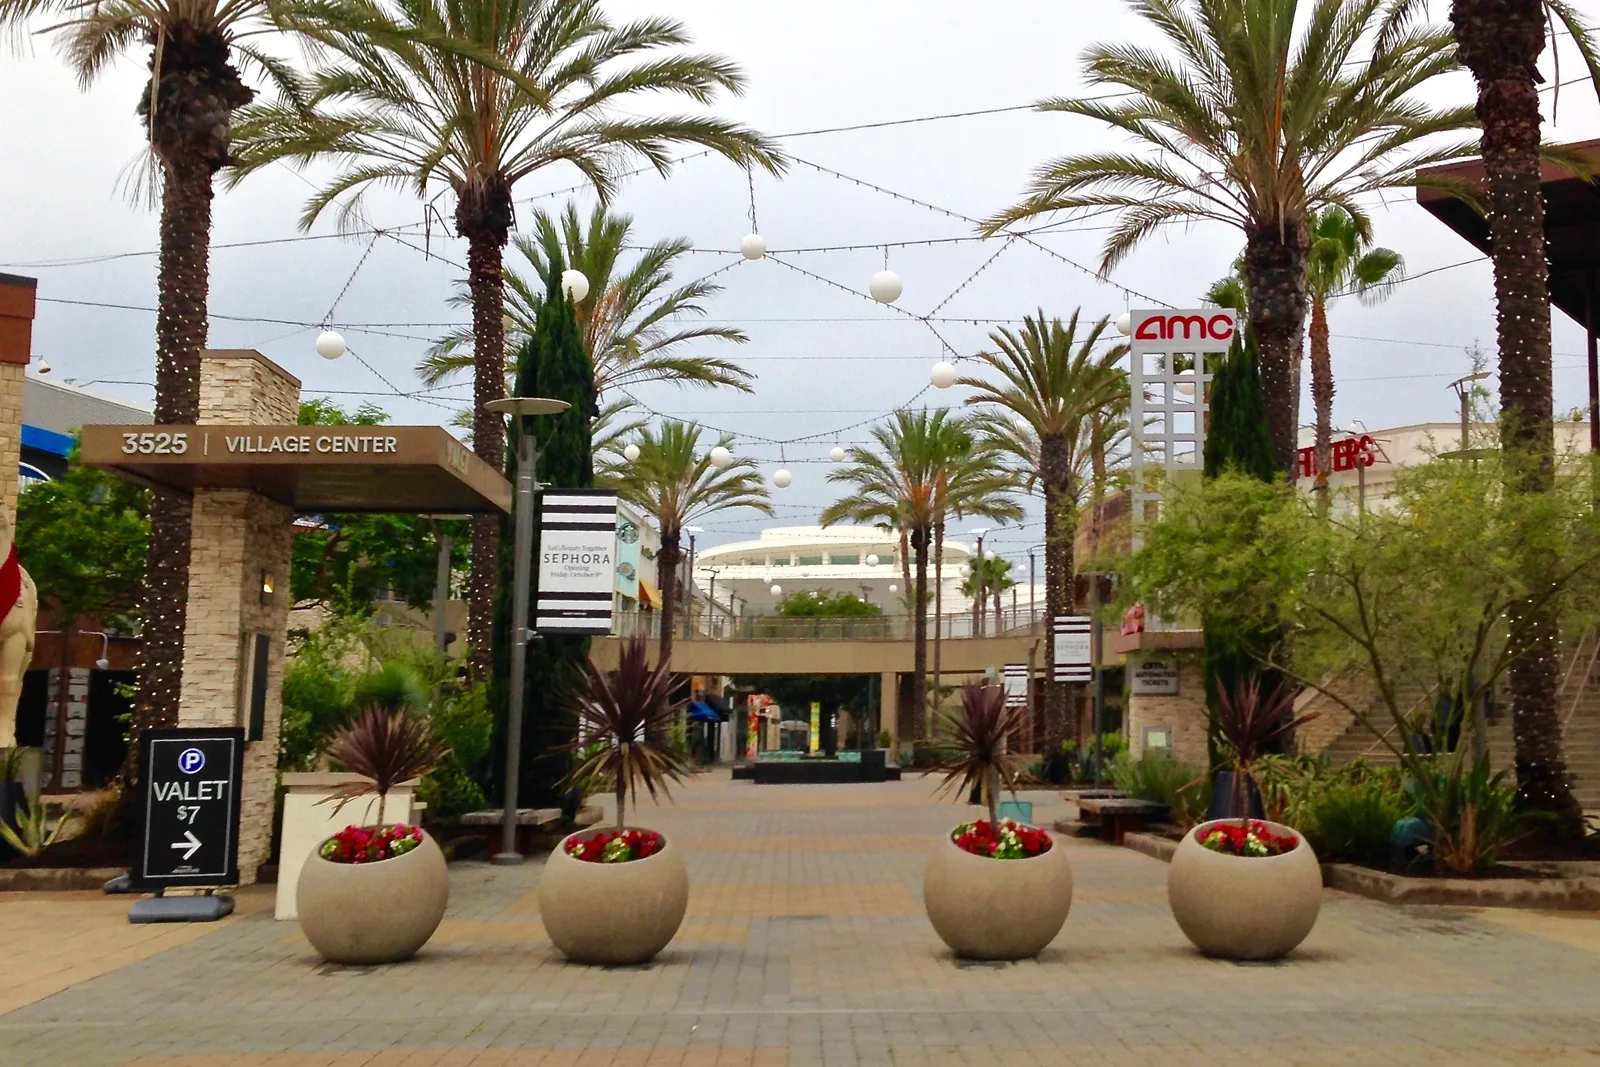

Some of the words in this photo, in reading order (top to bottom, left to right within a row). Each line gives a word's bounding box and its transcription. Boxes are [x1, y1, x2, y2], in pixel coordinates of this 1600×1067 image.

[1135, 314, 1233, 340] amc
[121, 432, 188, 454] 3525
[225, 436, 310, 453] VILLAGE
[315, 436, 397, 453] CENTER
[543, 553, 610, 564] SEPHORA
[153, 780, 228, 801] VALET
[176, 805, 201, 824] $7
